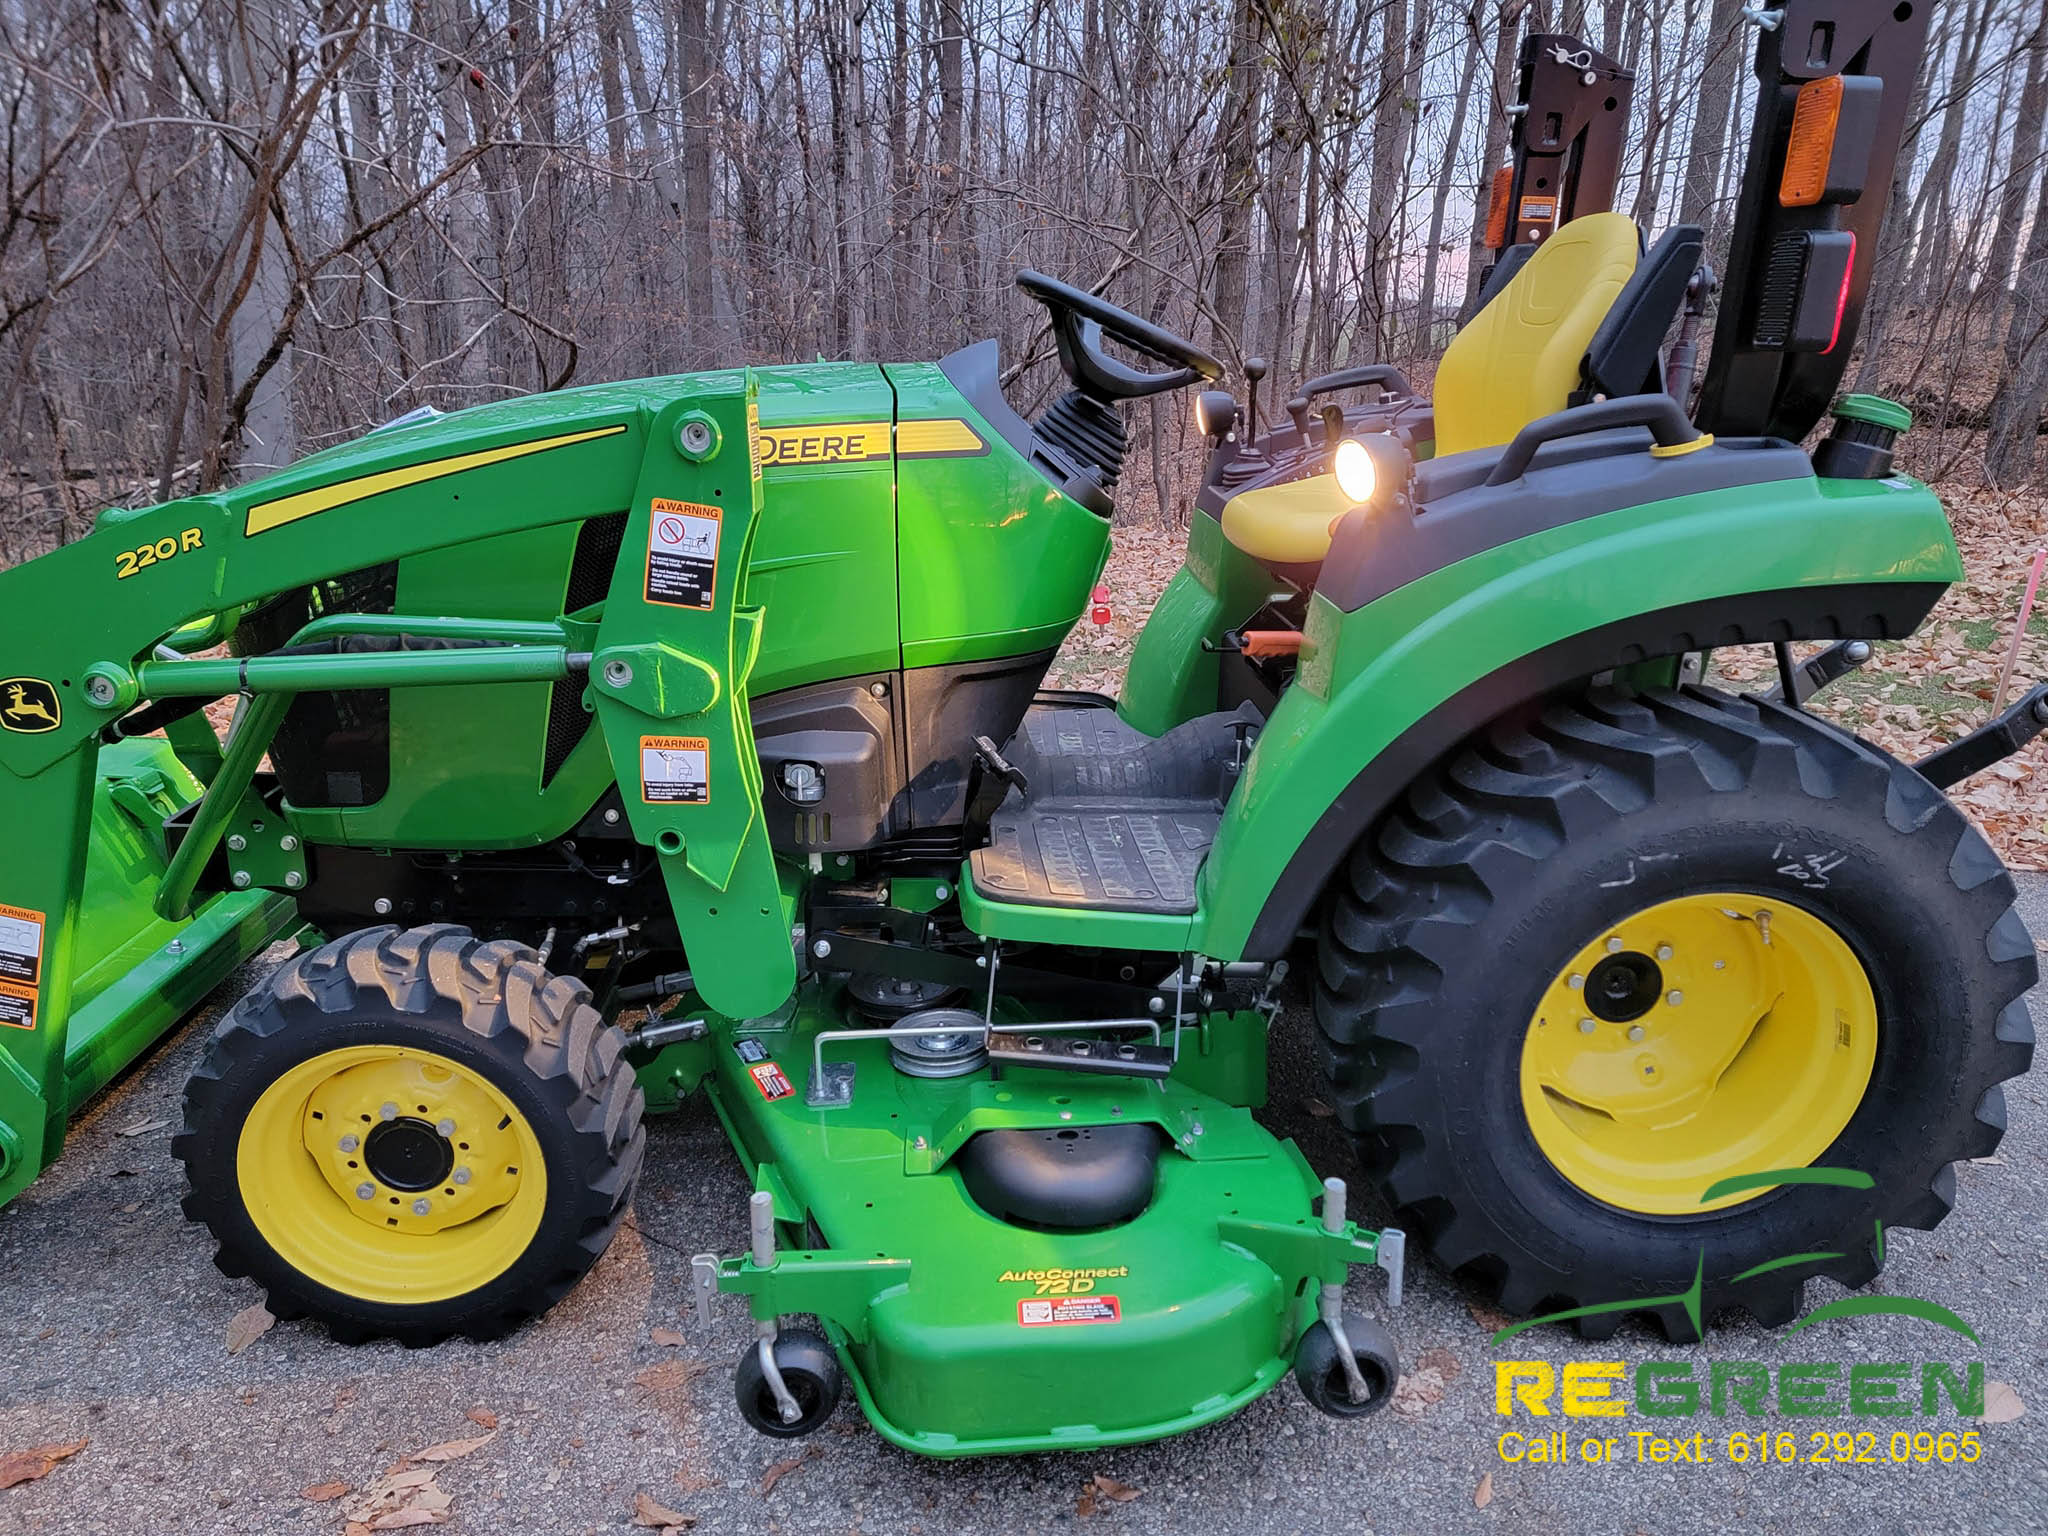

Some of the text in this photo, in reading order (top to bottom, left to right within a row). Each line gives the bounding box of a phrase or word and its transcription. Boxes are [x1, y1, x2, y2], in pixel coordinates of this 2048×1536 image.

[760, 435, 865, 460] DEERE
[666, 501, 718, 518] WARNING
[653, 739, 705, 748] WARNING
[0, 907, 36, 921] ARNING
[998, 1265, 1129, 1282] AutoConnect
[1034, 1278, 1096, 1295] 72D
